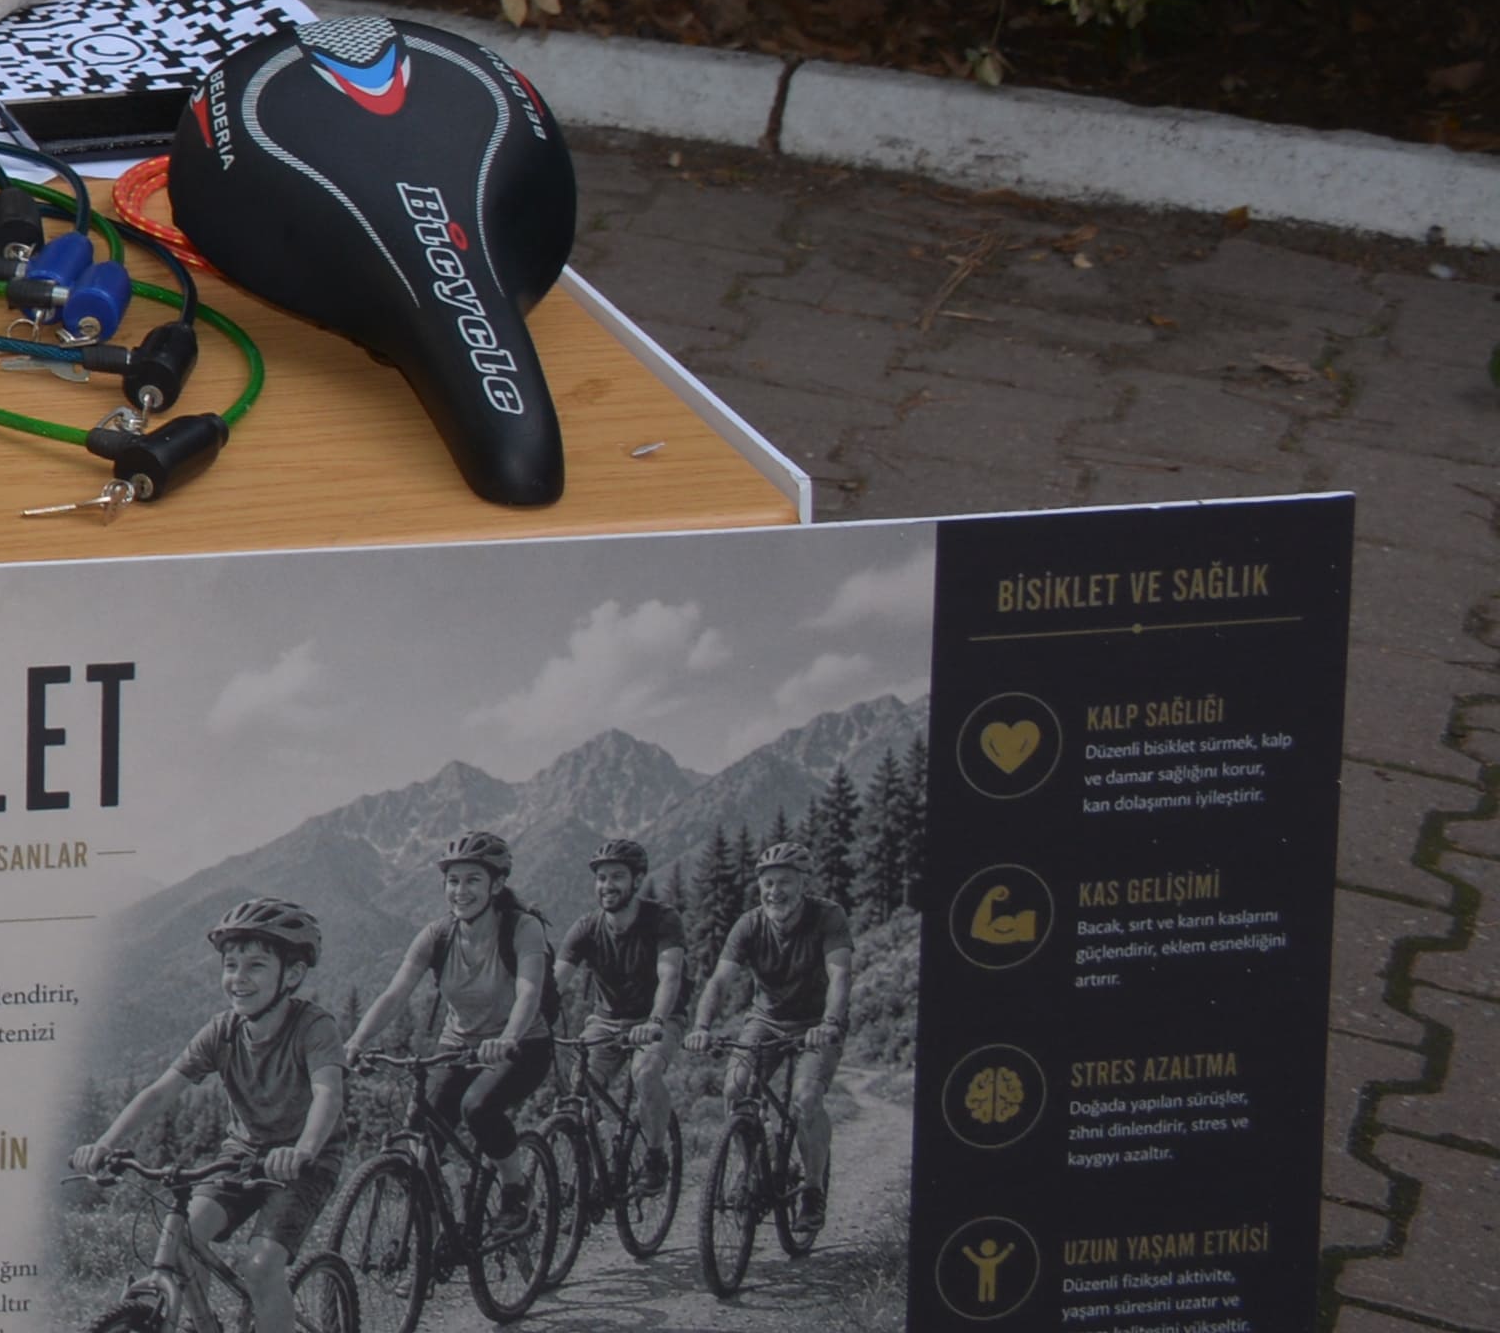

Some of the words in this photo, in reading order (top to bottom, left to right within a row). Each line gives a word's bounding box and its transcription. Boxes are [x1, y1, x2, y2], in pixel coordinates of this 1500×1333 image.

[210, 70, 234, 171] BELDERIA
[397, 183, 523, 415] Bicycle
[998, 570, 1119, 613] BİSİKLET
[1130, 571, 1161, 604] VE
[1173, 562, 1269, 601] SAĞLIK
[1087, 705, 1139, 731] KALP
[1146, 694, 1224, 727] SAĞLIĞI
[1086, 743, 1139, 760] Düzenli
[1144, 738, 1196, 756] bisiklet
[1200, 736, 1258, 753] sürmek,
[1262, 733, 1292, 750] kalp
[1080, 881, 1119, 907] KAS
[1127, 869, 1220, 906] GELİŞİMİ
[1071, 1060, 1136, 1088] STRES
[1144, 1053, 1237, 1082] AZALTMA
[1064, 1239, 1118, 1265] UZUN
[1127, 1234, 1195, 1263] YAŞAM
[1204, 1223, 1269, 1255] ETKİSİ
